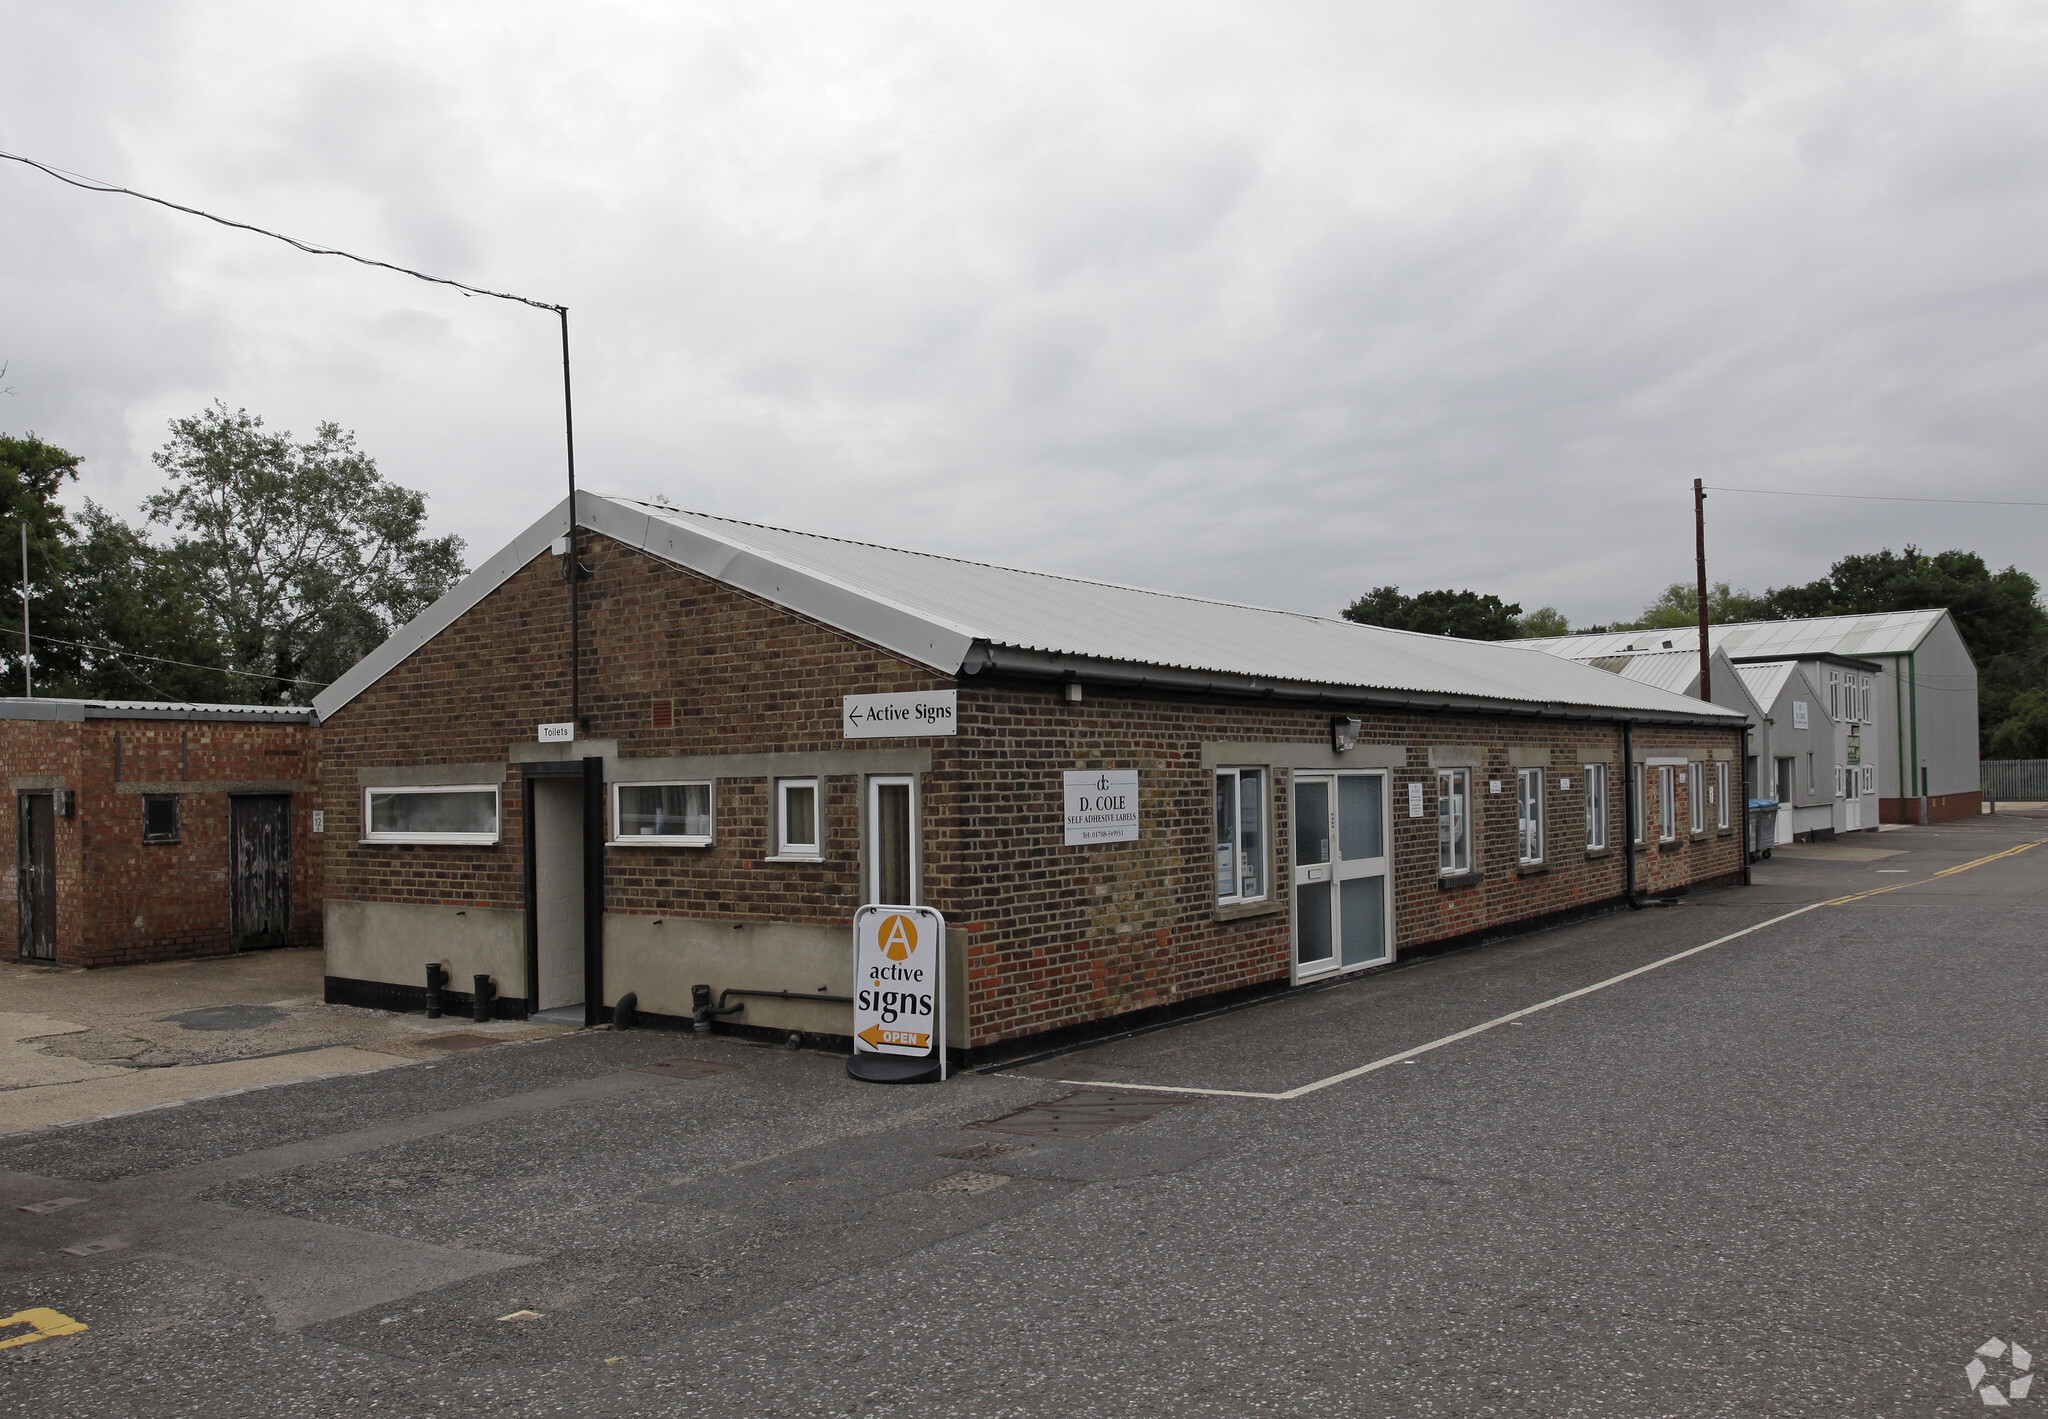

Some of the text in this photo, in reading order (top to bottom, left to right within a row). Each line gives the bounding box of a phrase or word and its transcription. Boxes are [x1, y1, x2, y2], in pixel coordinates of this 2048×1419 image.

[866, 703, 952, 724] Active Signs
[544, 727, 568, 736] Toilets
[1080, 795, 1126, 811] D. COLE
[314, 817, 322, 826] 12
[1067, 812, 1137, 824] SELF ADHESIVE LABELS
[869, 962, 923, 982] active
[858, 980, 932, 1023] signs
[883, 1031, 917, 1045] OPEN
